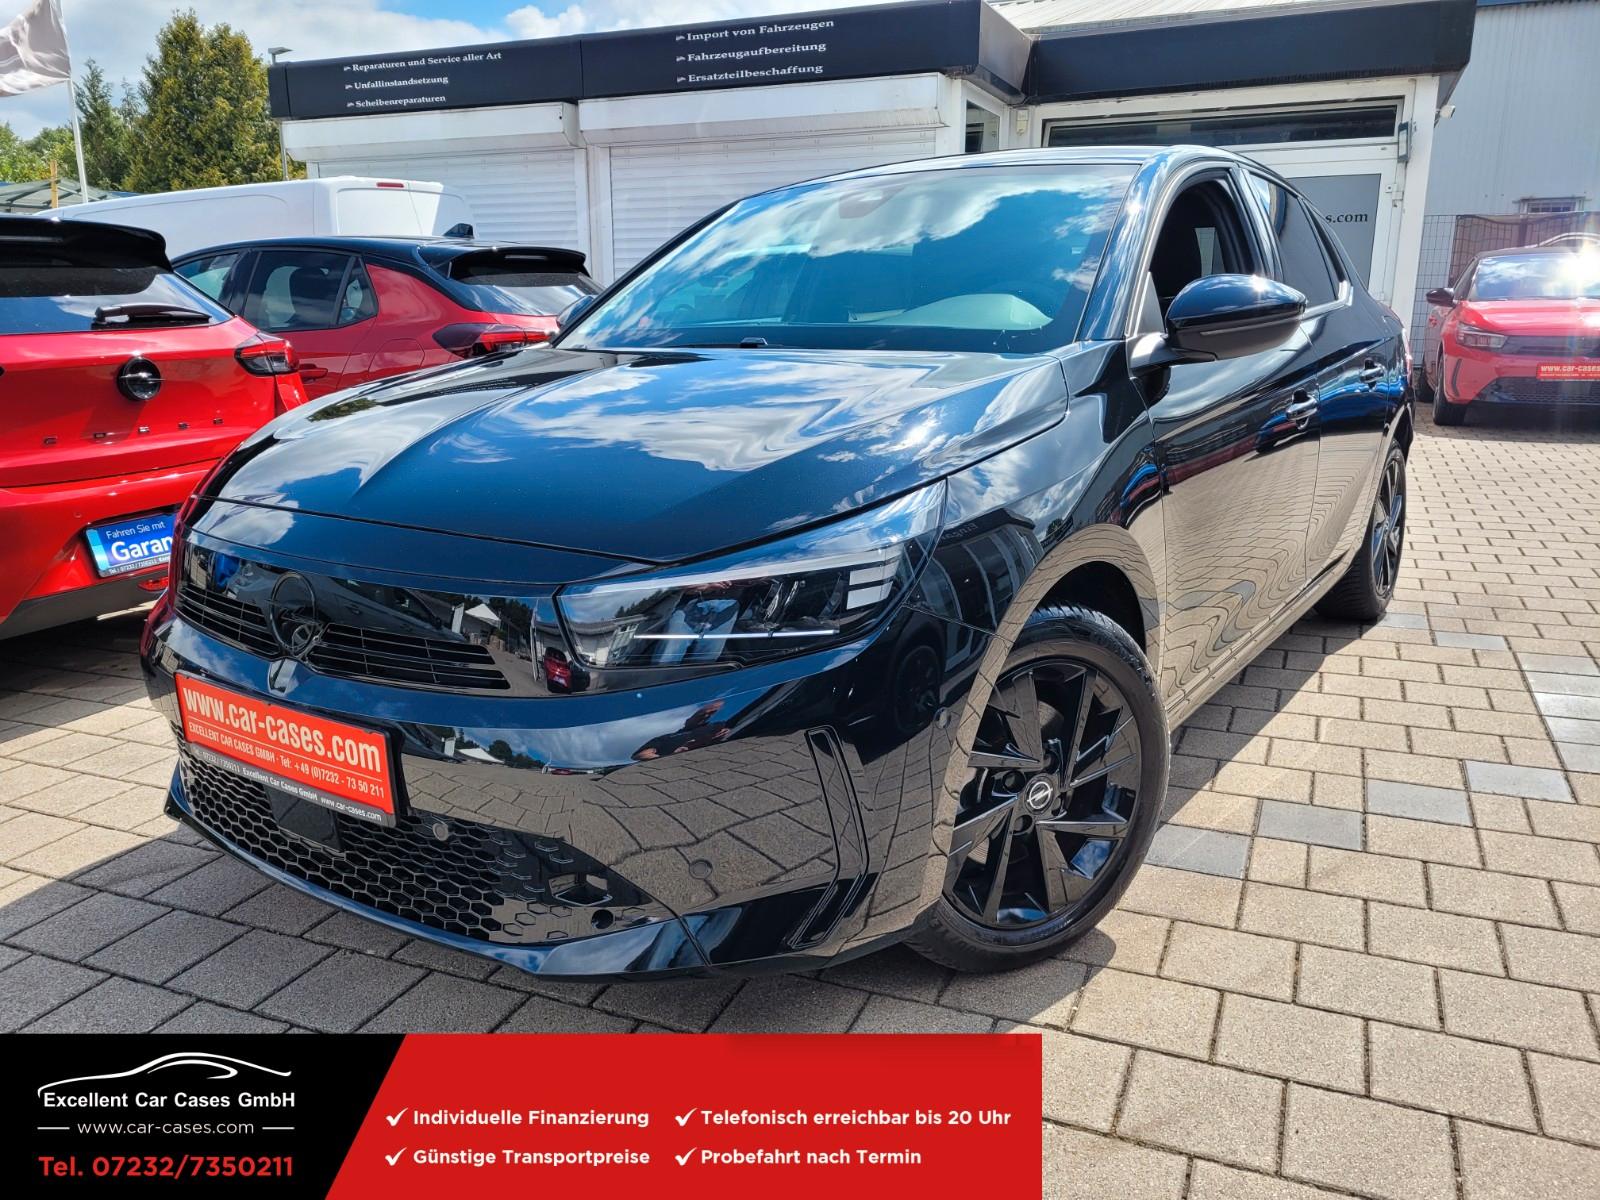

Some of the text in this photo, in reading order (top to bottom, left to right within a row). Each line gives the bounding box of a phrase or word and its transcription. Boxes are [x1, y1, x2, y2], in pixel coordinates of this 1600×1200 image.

[687, 20, 835, 42] Import von Fahrzeugen
[352, 51, 502, 72] Reparaturen und Service aller Art
[687, 42, 827, 62] Fahrzeugaufbereitung
[354, 76, 449, 90] Unfallinstandsetzung
[688, 65, 824, 83] Ersatzteilbeschaffung
[355, 95, 446, 108] Scheibenreparaturen
[106, 521, 166, 540] Fahren Sie mit
[183, 687, 382, 773] www.car-cases.com
[188, 722, 219, 744] EXCELLENT
[220, 733, 233, 747] CAR
[233, 738, 255, 757] CASES
[255, 746, 276, 764] GMBH
[294, 761, 310, 775] +49
[311, 766, 340, 784] (0)7232
[346, 776, 357, 789] 73
[358, 780, 368, 793] 50
[369, 784, 384, 798] 211
[242, 767, 269, 782] Excellent
[269, 777, 280, 787] Car
[280, 780, 298, 795] Cases
